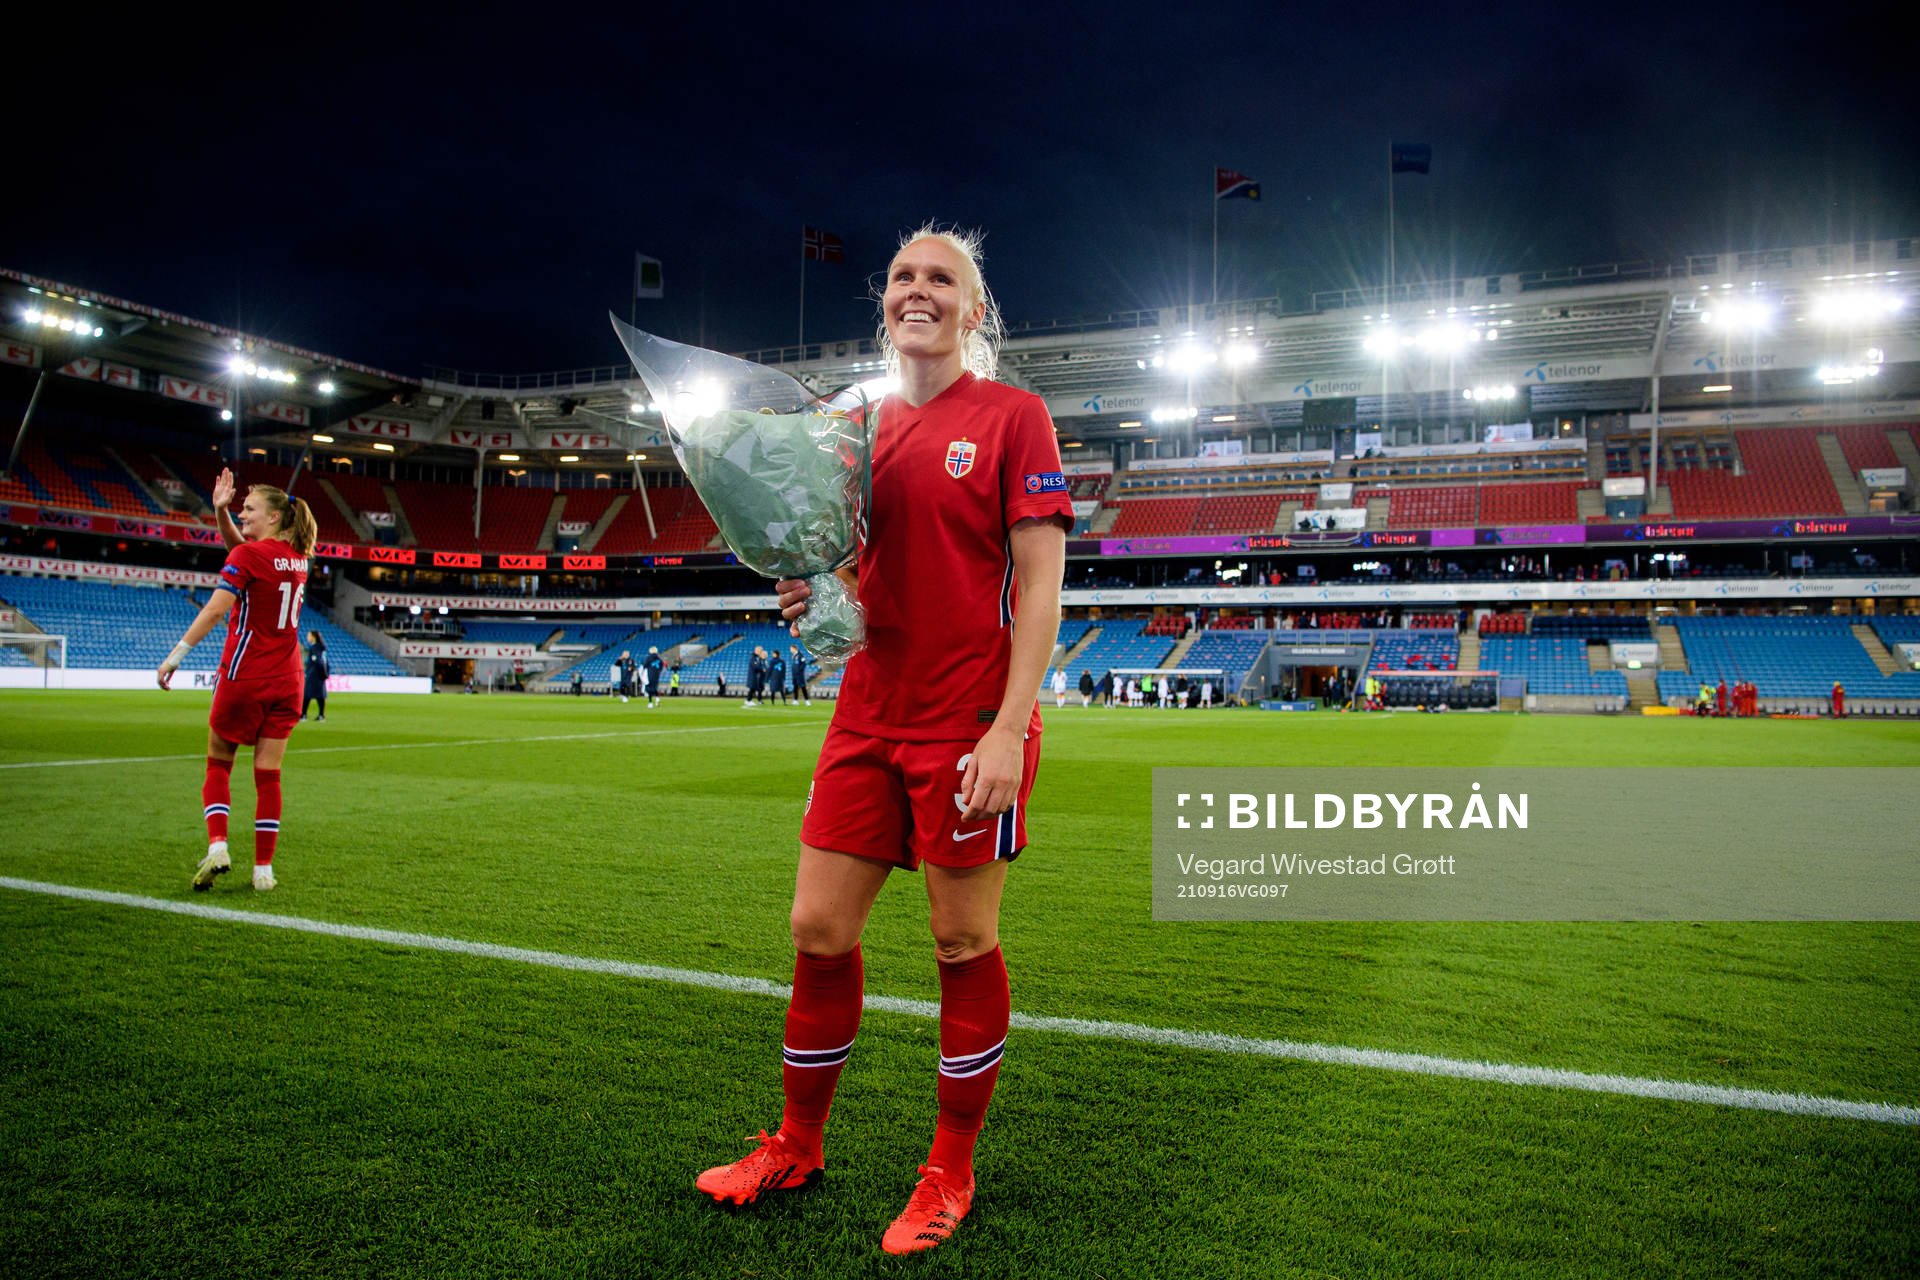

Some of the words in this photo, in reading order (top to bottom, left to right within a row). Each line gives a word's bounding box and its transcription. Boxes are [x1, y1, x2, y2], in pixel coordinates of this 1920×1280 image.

[1718, 352, 1776, 366] telenor
[1548, 363, 1601, 378] telenor
[165, 379, 227, 405] VG
[1315, 380, 1362, 394] telenor
[1102, 396, 1144, 409] telenor
[350, 417, 410, 438] VG
[451, 430, 512, 447] VG
[552, 432, 609, 448] VG
